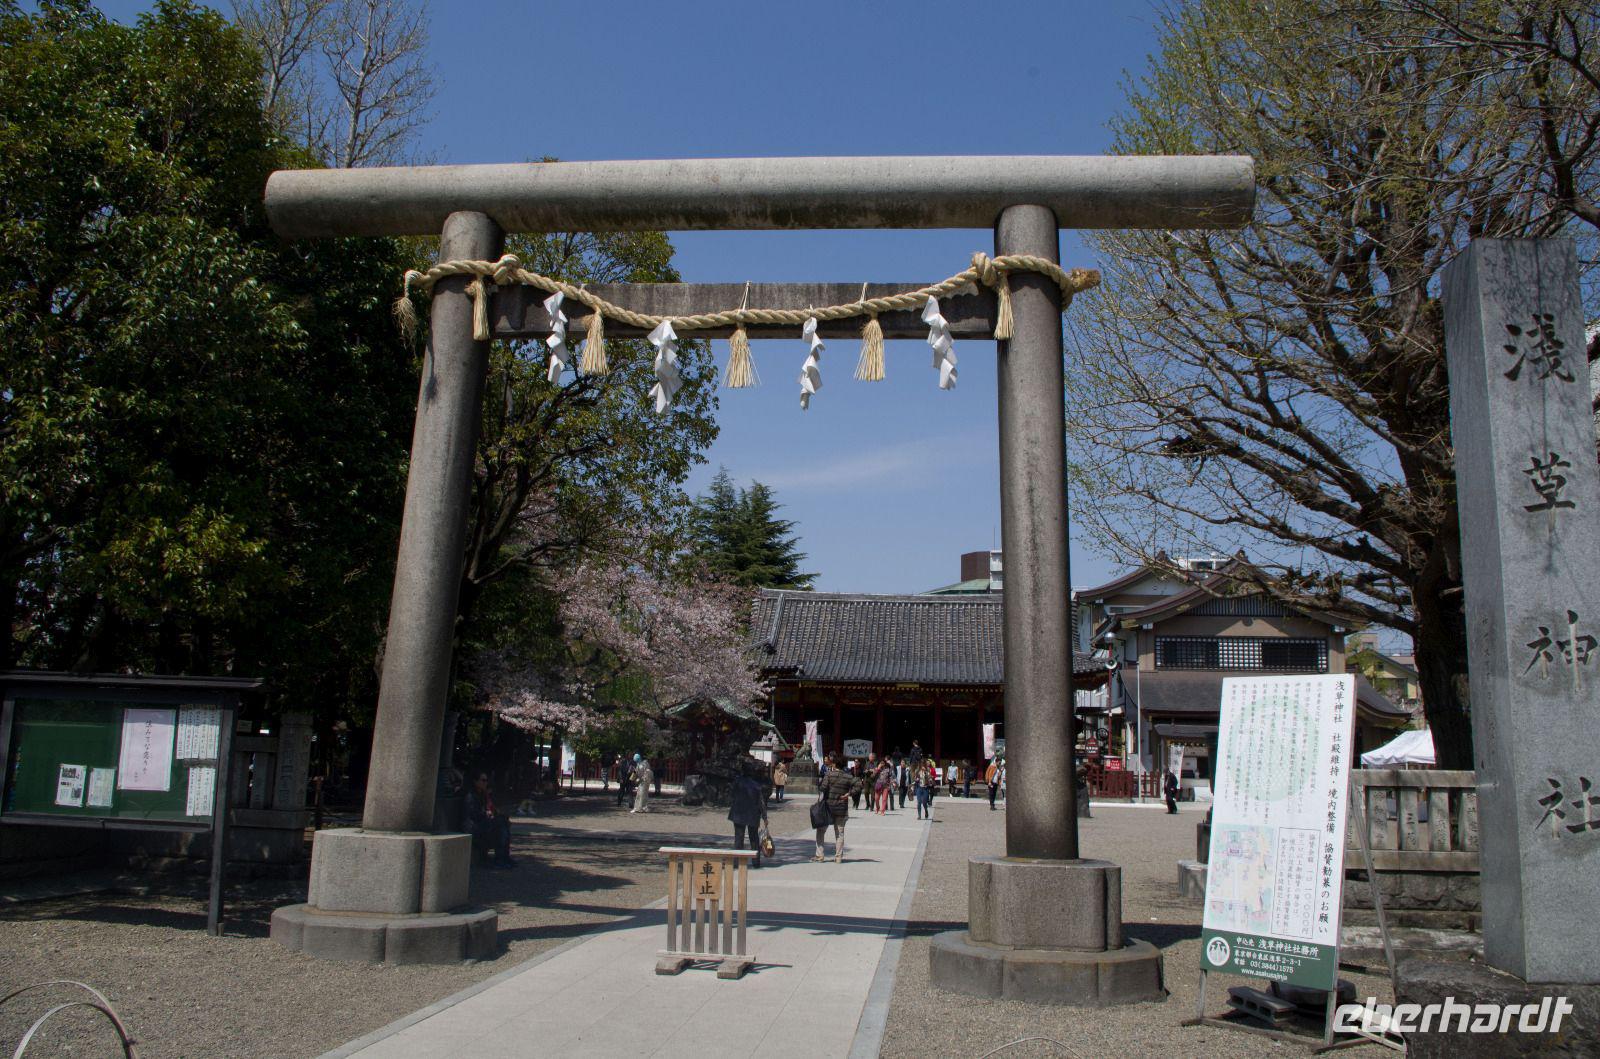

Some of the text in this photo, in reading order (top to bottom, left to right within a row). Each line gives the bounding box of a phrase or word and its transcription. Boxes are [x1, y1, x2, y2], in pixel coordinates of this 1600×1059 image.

[1334, 680, 1345, 724] 浅草神社
[1326, 733, 1342, 834] 社殿維持・境内整備
[699, 861, 715, 895] 車止
[1234, 957, 1246, 967] 電話
[1258, 938, 1319, 958] 浅草神社社務所
